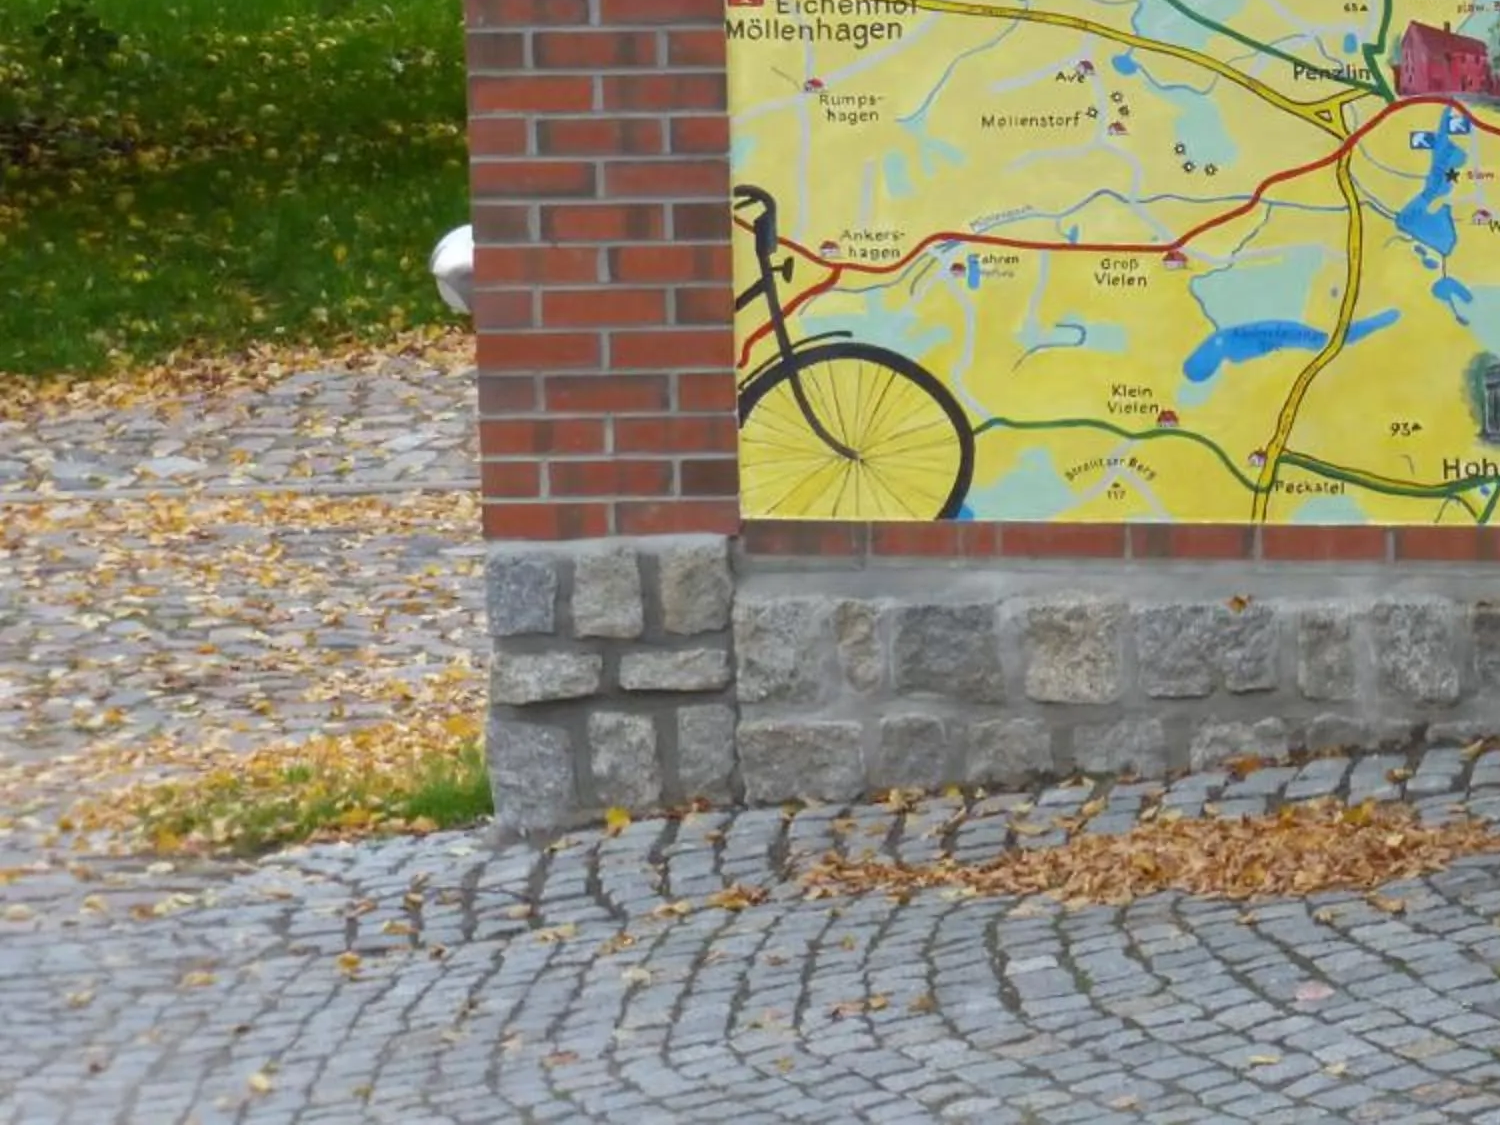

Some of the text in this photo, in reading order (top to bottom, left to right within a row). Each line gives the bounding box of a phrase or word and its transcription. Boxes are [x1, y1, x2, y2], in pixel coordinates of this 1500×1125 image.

[725, 18, 903, 49] Möllenhagen
[1055, 72, 1086, 84] Ave
[827, 109, 879, 125] hagen
[849, 246, 901, 261] hagen
[1100, 258, 1139, 272] Groß
[1094, 272, 1147, 288] Vielen
[1112, 384, 1152, 398] Klein
[1107, 401, 1159, 416] Vielen
